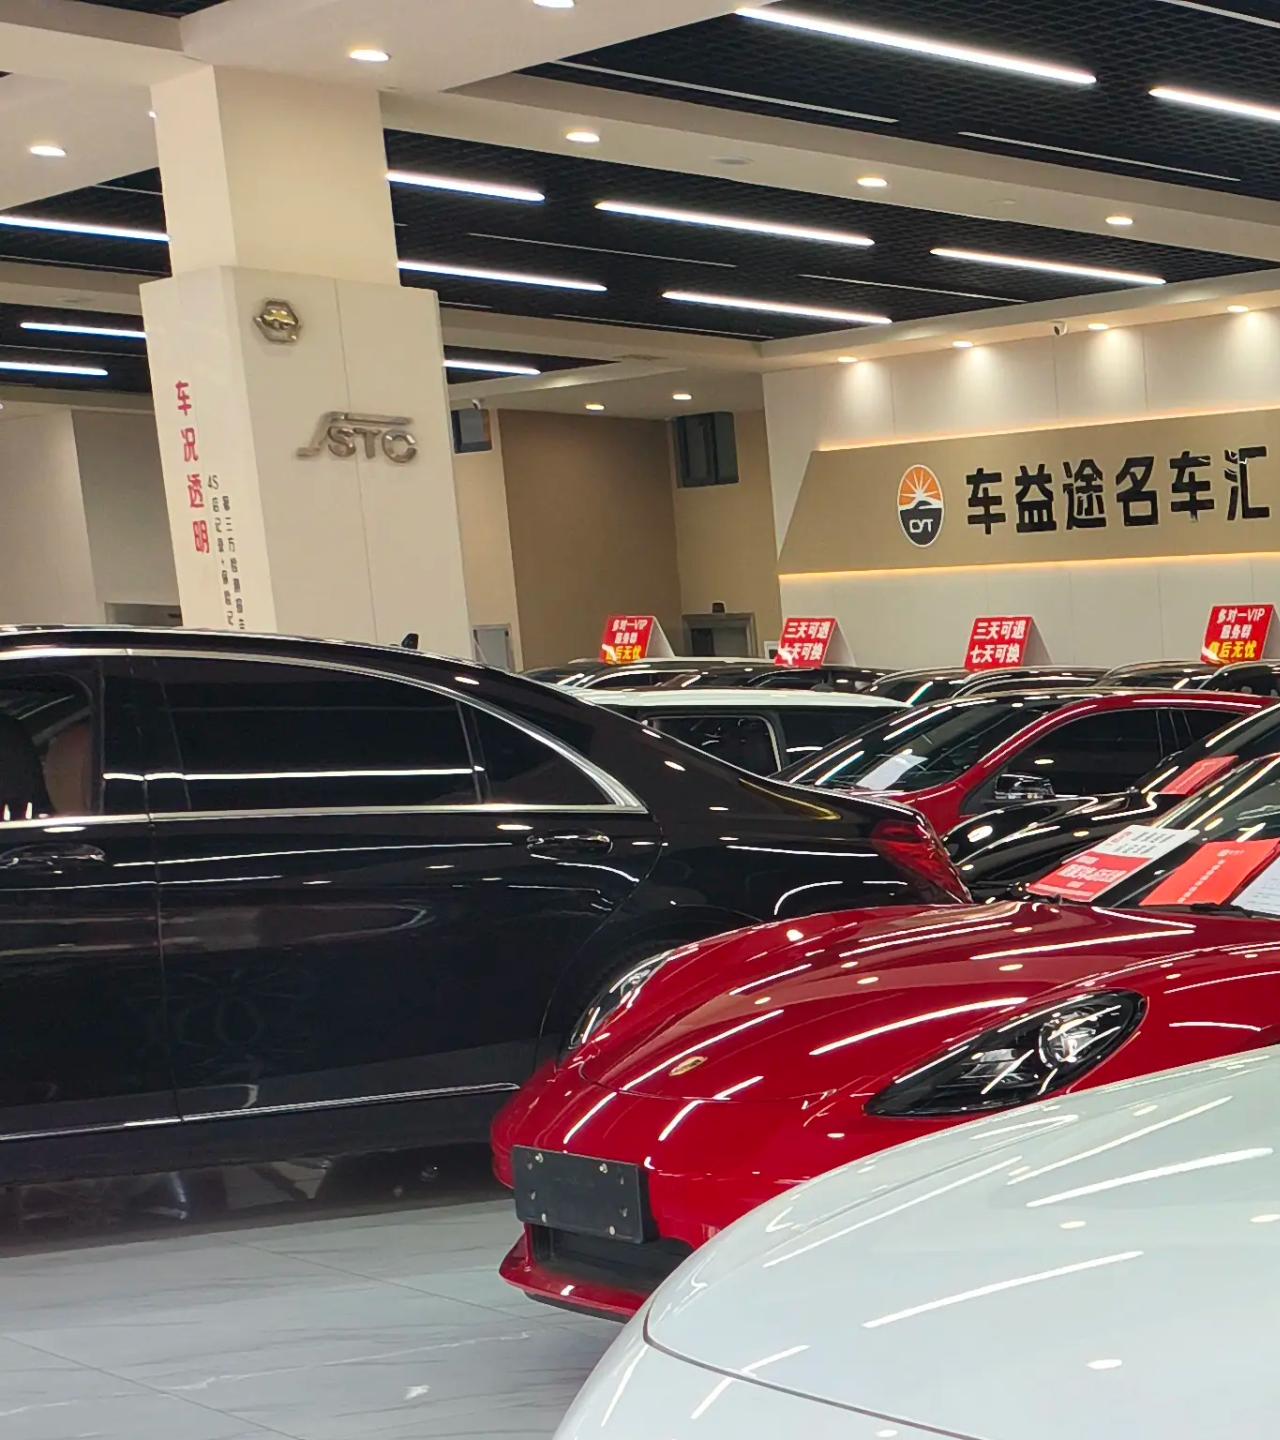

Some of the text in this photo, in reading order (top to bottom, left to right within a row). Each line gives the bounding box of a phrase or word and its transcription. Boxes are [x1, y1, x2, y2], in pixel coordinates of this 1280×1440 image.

[176, 380, 210, 554] 车况透明
[965, 446, 1271, 536] 车益途名车汇
[784, 621, 831, 639] 三天可退
[973, 619, 1027, 640] 三天可退
[969, 643, 1020, 664] 七天可换
